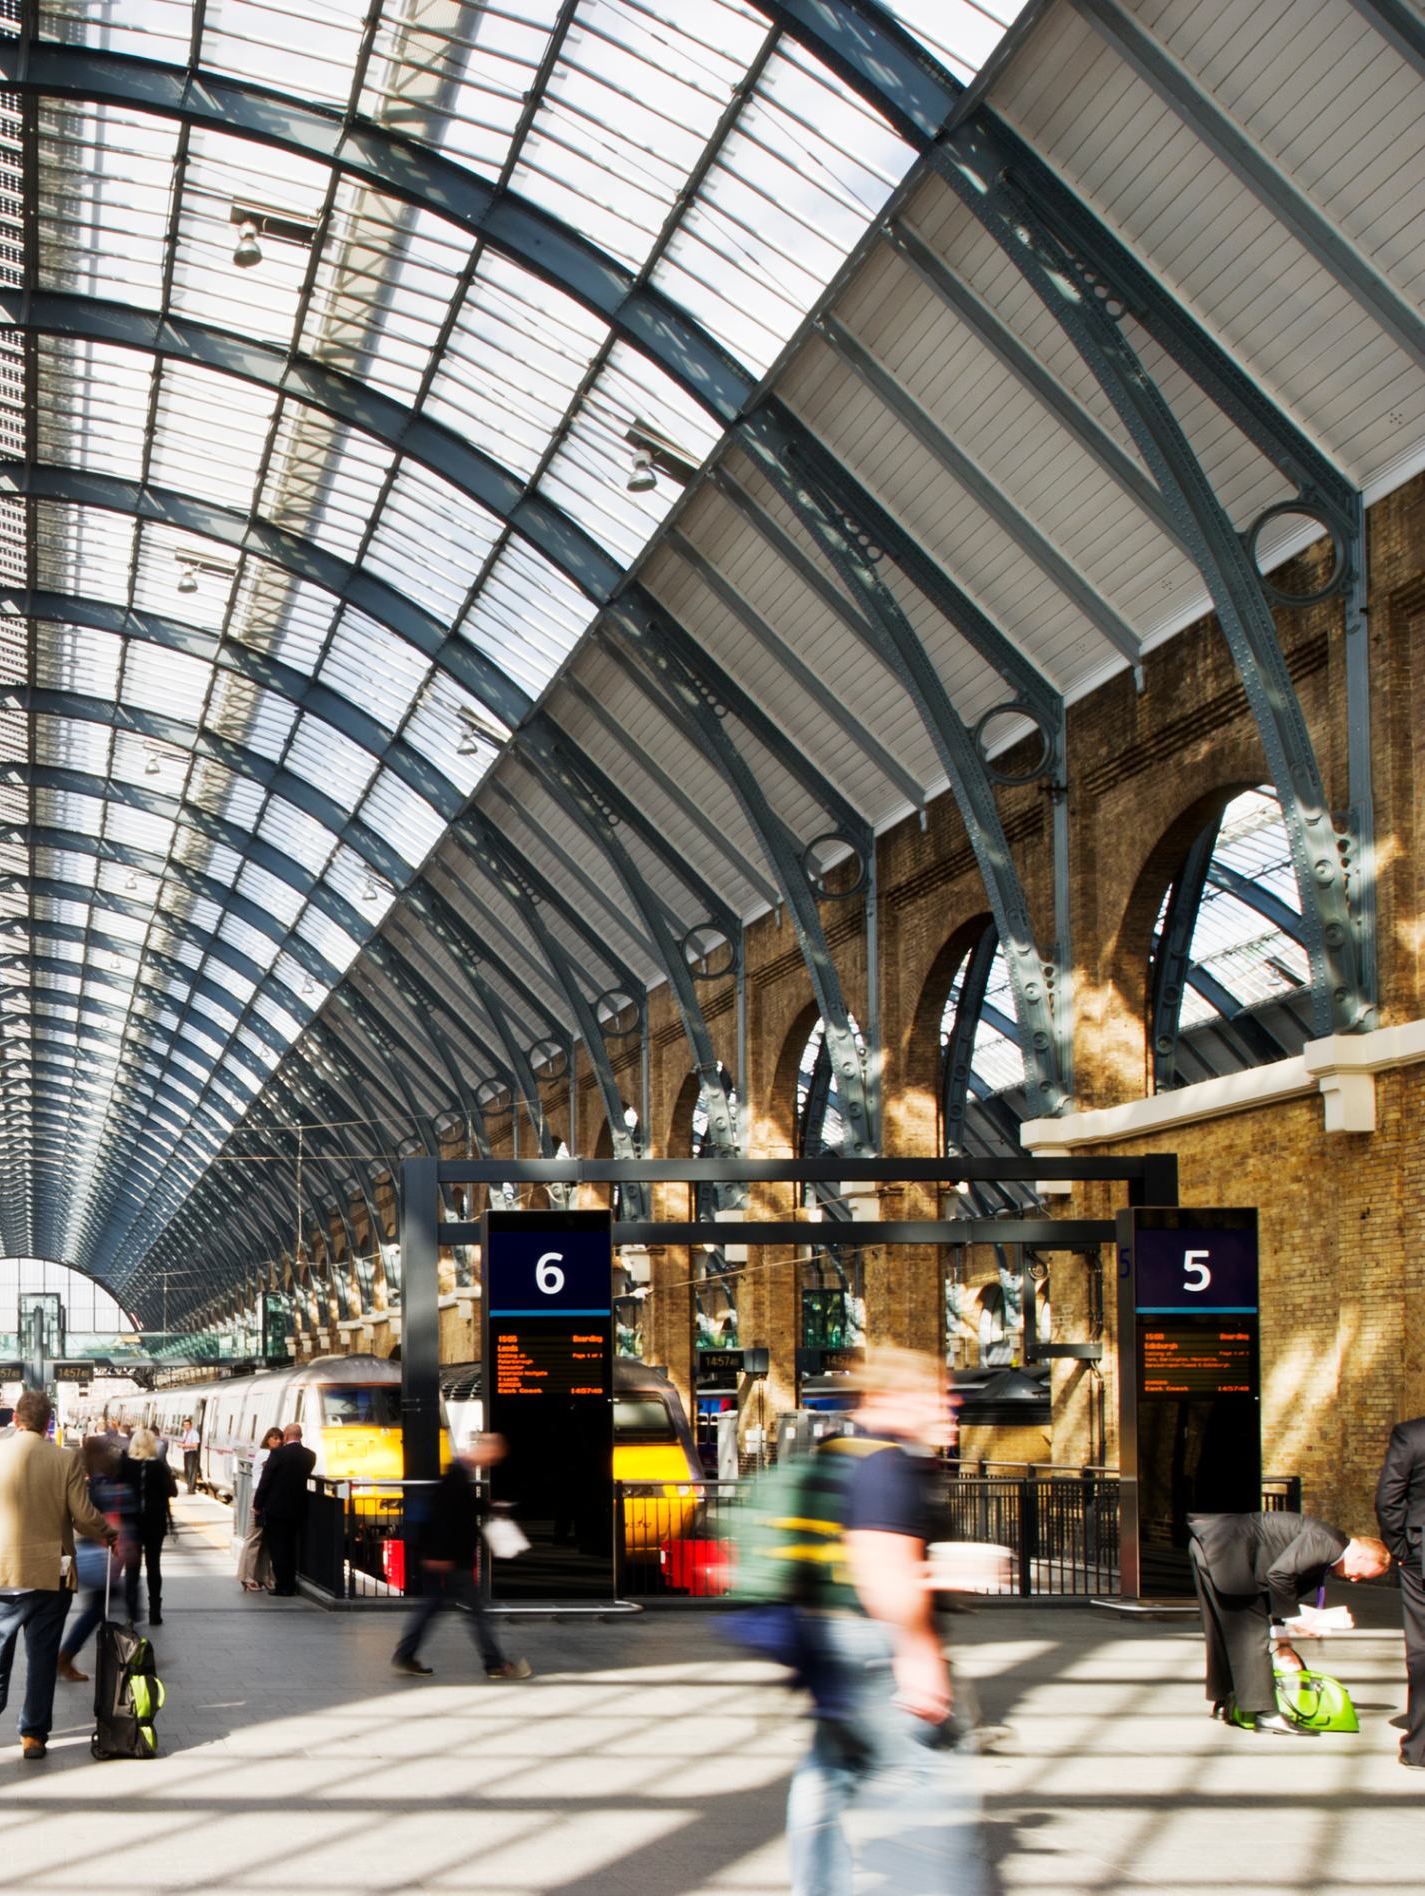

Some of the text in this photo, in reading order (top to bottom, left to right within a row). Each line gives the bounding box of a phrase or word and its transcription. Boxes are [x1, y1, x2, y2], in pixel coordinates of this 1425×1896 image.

[535, 1252, 565, 1295] 6
[1119, 1248, 1131, 1279] 5
[1183, 1250, 1211, 1292] 5
[573, 1335, 603, 1343] Boarding
[1144, 1342, 1178, 1350] Edinburgh
